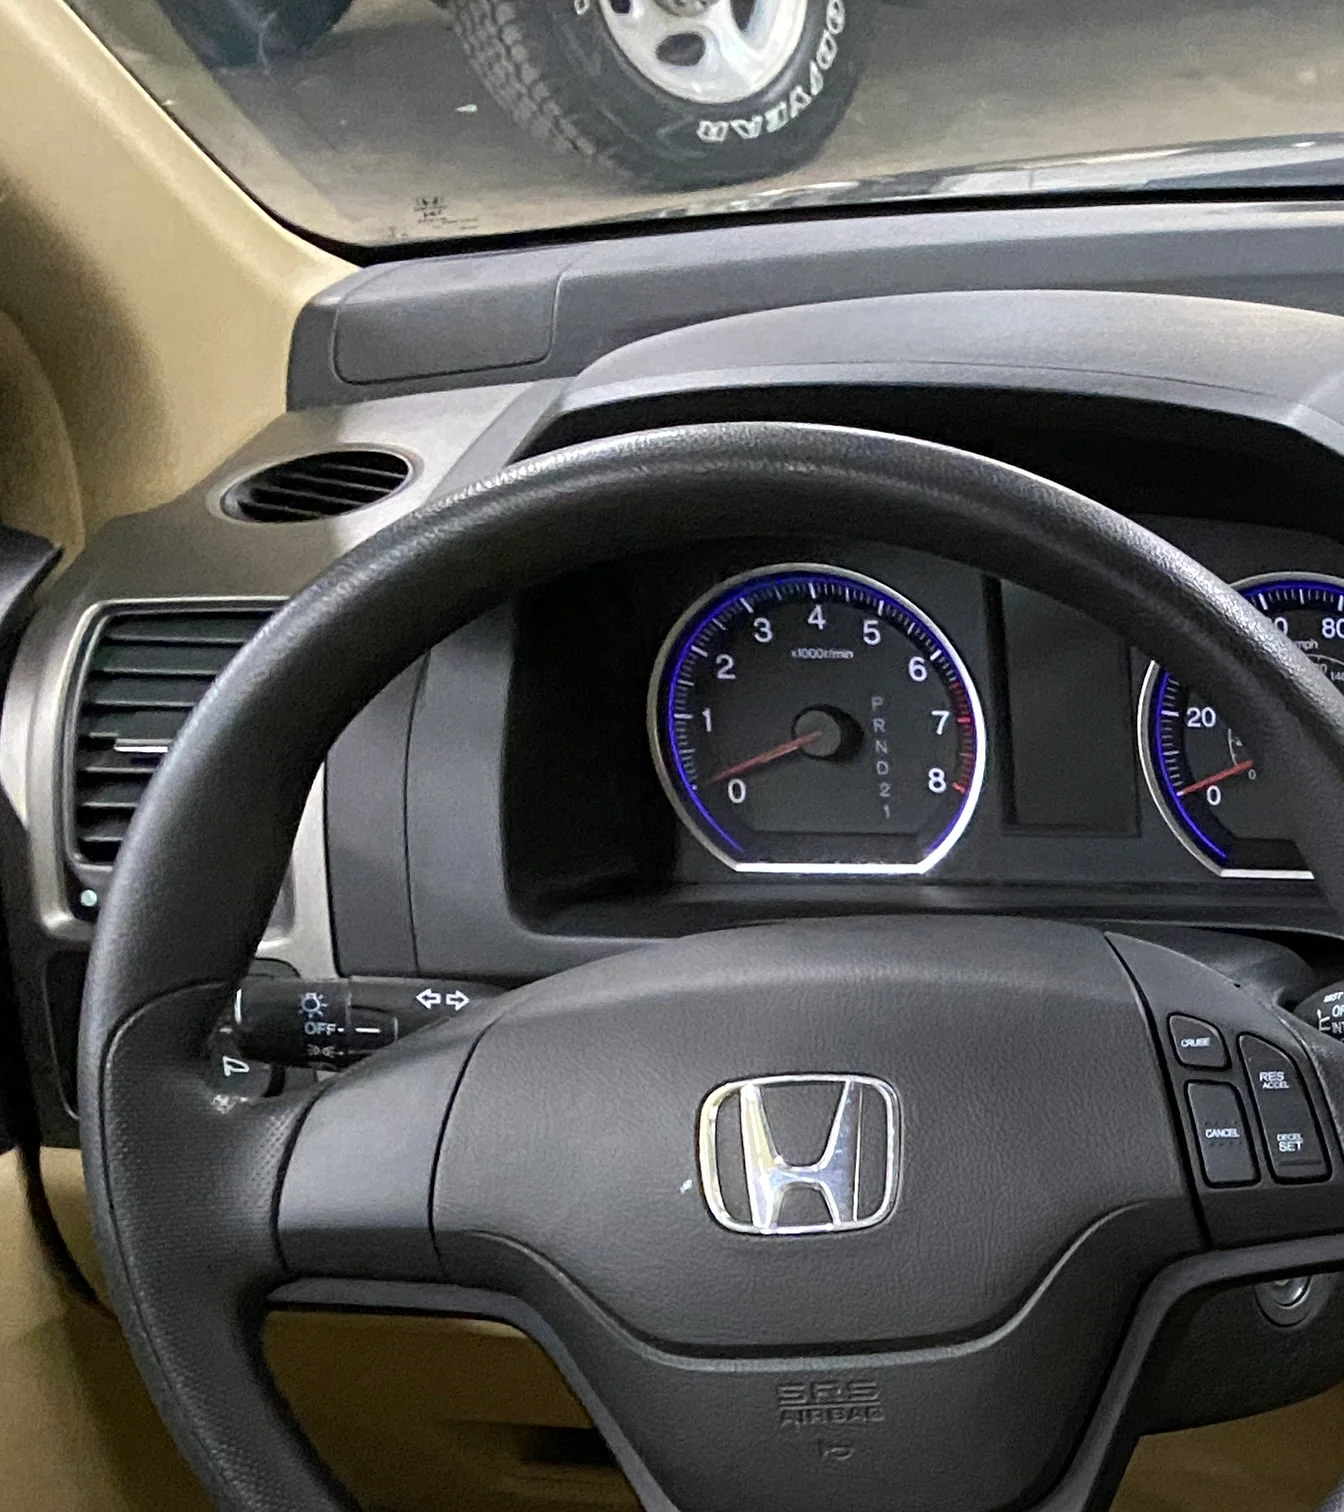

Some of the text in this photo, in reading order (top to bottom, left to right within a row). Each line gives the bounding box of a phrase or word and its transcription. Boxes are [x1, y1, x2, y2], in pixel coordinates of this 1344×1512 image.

[696, 0, 845, 143] OODYEAR
[807, 604, 826, 630] 4
[753, 618, 773, 643] 3
[863, 620, 881, 645] 5
[715, 654, 736, 680] 2
[908, 656, 927, 682] 6
[701, 708, 713, 733] 1
[931, 710, 950, 735] 7
[1186, 706, 1217, 728] 20
[872, 696, 891, 819] P R N D 2 1
[727, 778, 746, 804] 0
[927, 768, 946, 793] 8
[1206, 784, 1221, 806] 0
[304, 1022, 336, 1036] OFF
[1259, 1071, 1285, 1081] RES
[1262, 1081, 1289, 1089] ACCEL
[1205, 1128, 1240, 1139] CANCEL
[1279, 1141, 1303, 1152] SET
